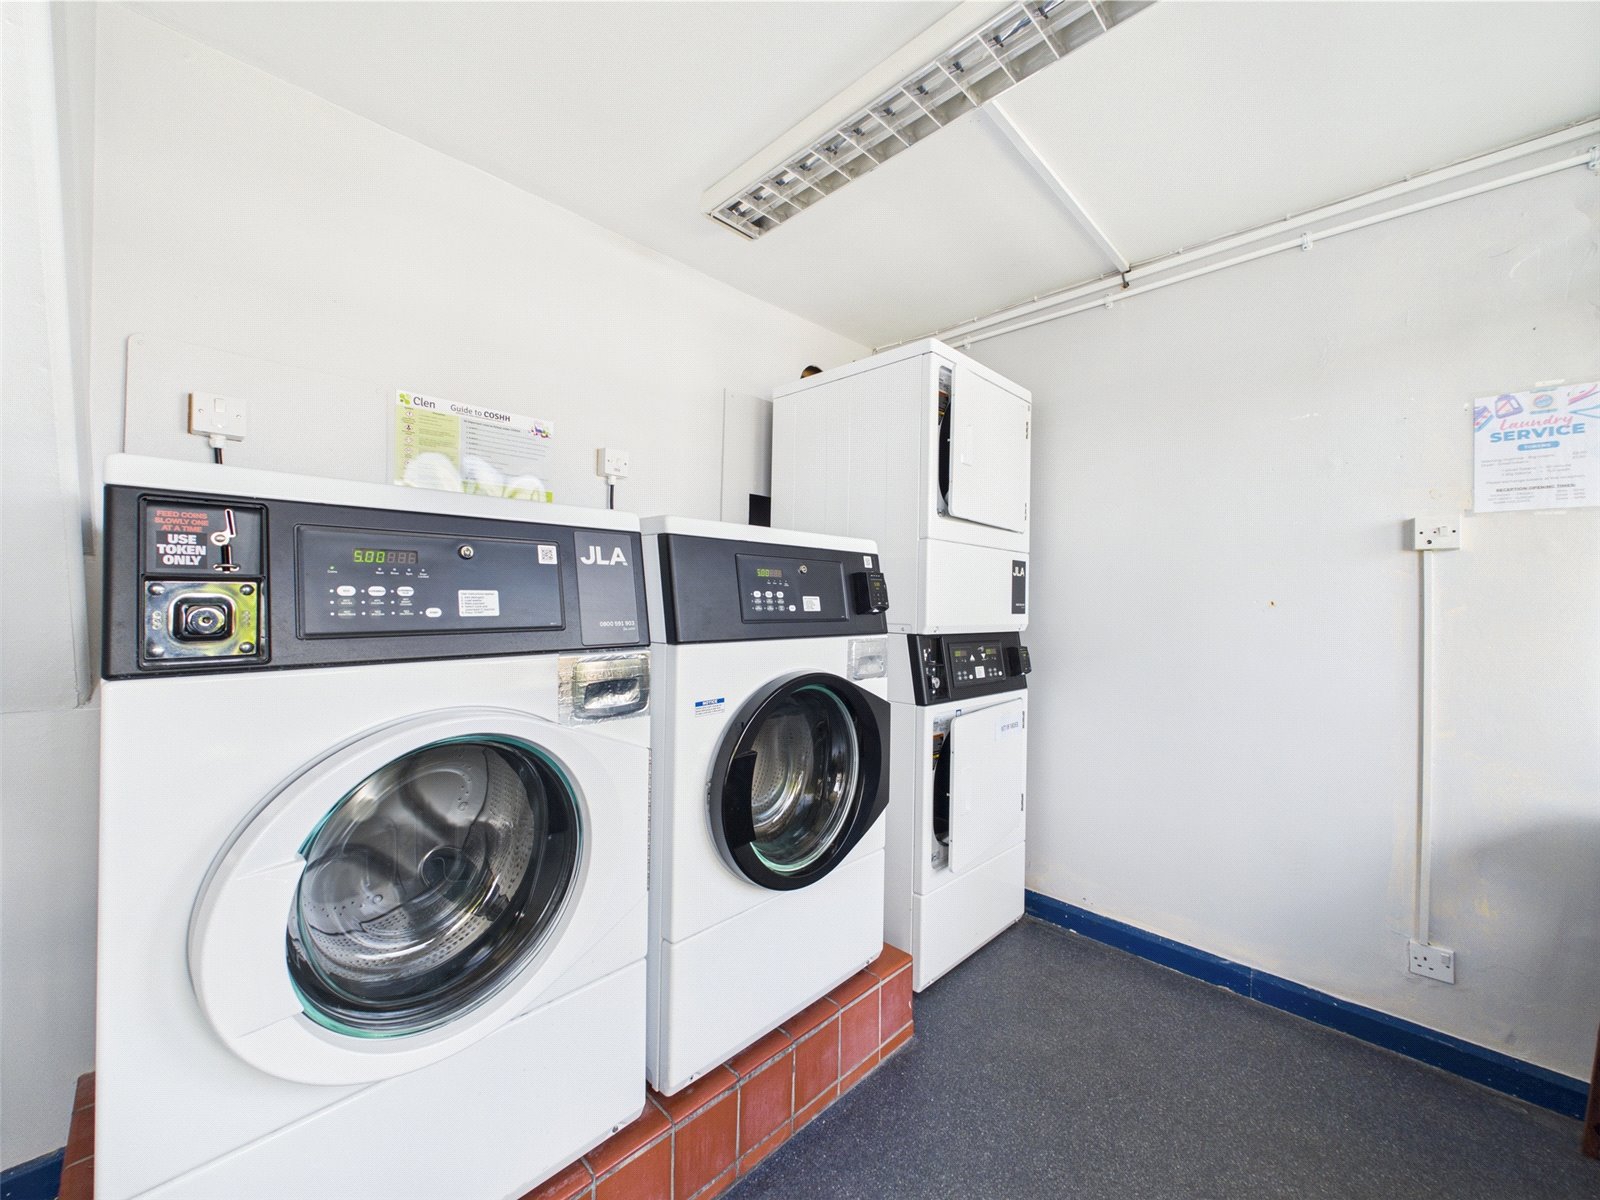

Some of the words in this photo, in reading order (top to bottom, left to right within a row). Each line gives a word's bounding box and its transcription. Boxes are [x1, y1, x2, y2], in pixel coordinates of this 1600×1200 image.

[413, 396, 436, 409] Clen
[450, 403, 473, 415] Guide
[475, 408, 482, 416] to
[484, 411, 511, 422] COSHH
[1500, 416, 1574, 431] Laundry
[1490, 423, 1585, 443] SERVICE
[156, 510, 179, 518] FEED
[181, 511, 208, 519] COINS
[154, 517, 190, 525] SLOWLY
[167, 534, 196, 544] USE
[157, 544, 206, 555] TOKEN
[162, 555, 201, 566] ONLY
[580, 545, 628, 566] JLA
[1012, 567, 1025, 577] JLA
